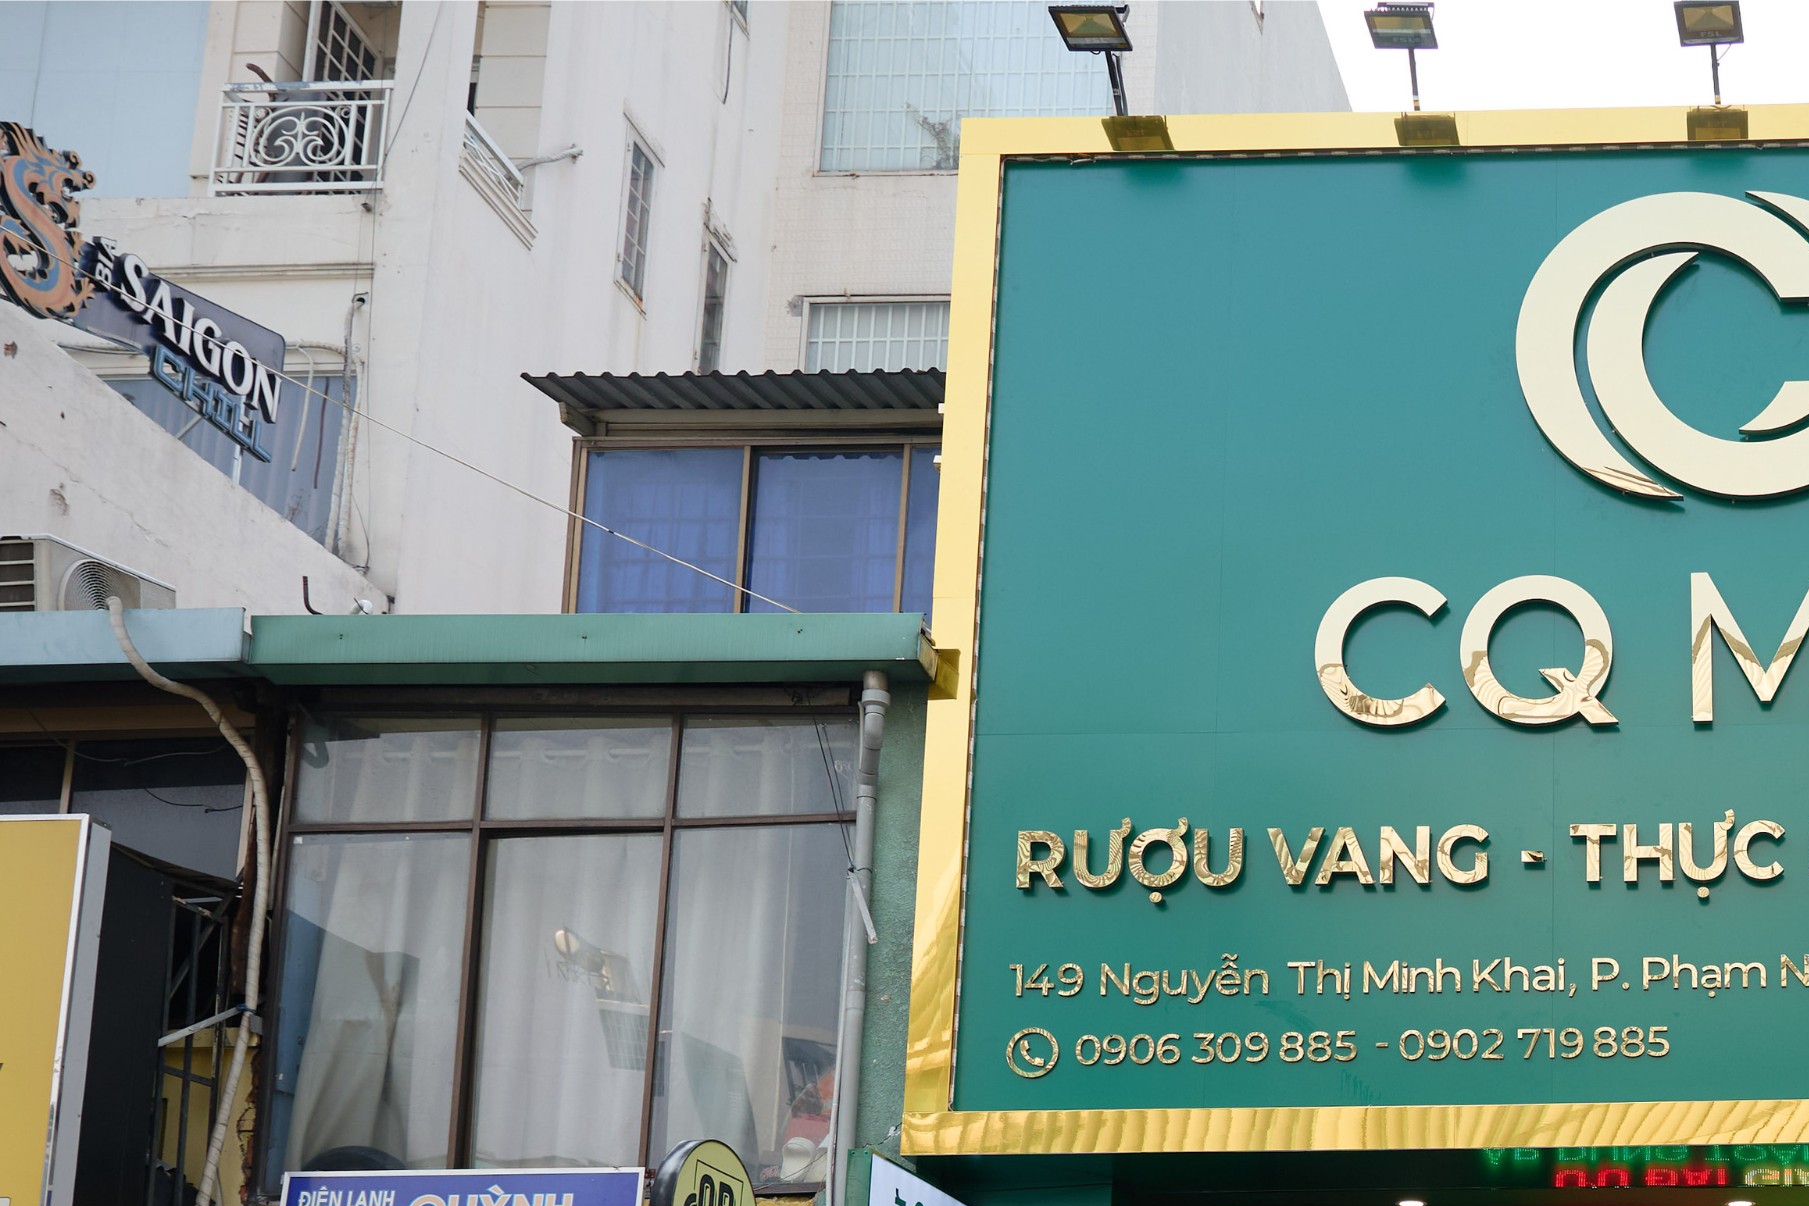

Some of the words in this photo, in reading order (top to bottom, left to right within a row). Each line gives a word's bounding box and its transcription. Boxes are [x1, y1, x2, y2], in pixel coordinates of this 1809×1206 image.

[120, 253, 283, 425] SAIGON
[1314, 574, 1620, 728] CQ
[1015, 816, 1246, 905] RƯỢU
[1267, 824, 1491, 888] VANG
[1569, 808, 1786, 902] THỰC
[1009, 962, 1086, 999] 149
[1098, 953, 1271, 1006] Nguyễn
[1287, 959, 1353, 1001] Thị
[1362, 957, 1463, 996] Minh
[1471, 956, 1578, 999] Khai,
[1590, 956, 1632, 992] P.
[1642, 954, 1767, 999] Phạm
[1074, 1032, 1182, 1067] 0906
[1190, 1030, 1270, 1066] 309
[1279, 1029, 1359, 1064] 885
[1398, 1027, 1506, 1063] 0902
[1517, 1026, 1585, 1061] 719
[1592, 1024, 1672, 1060] 885
